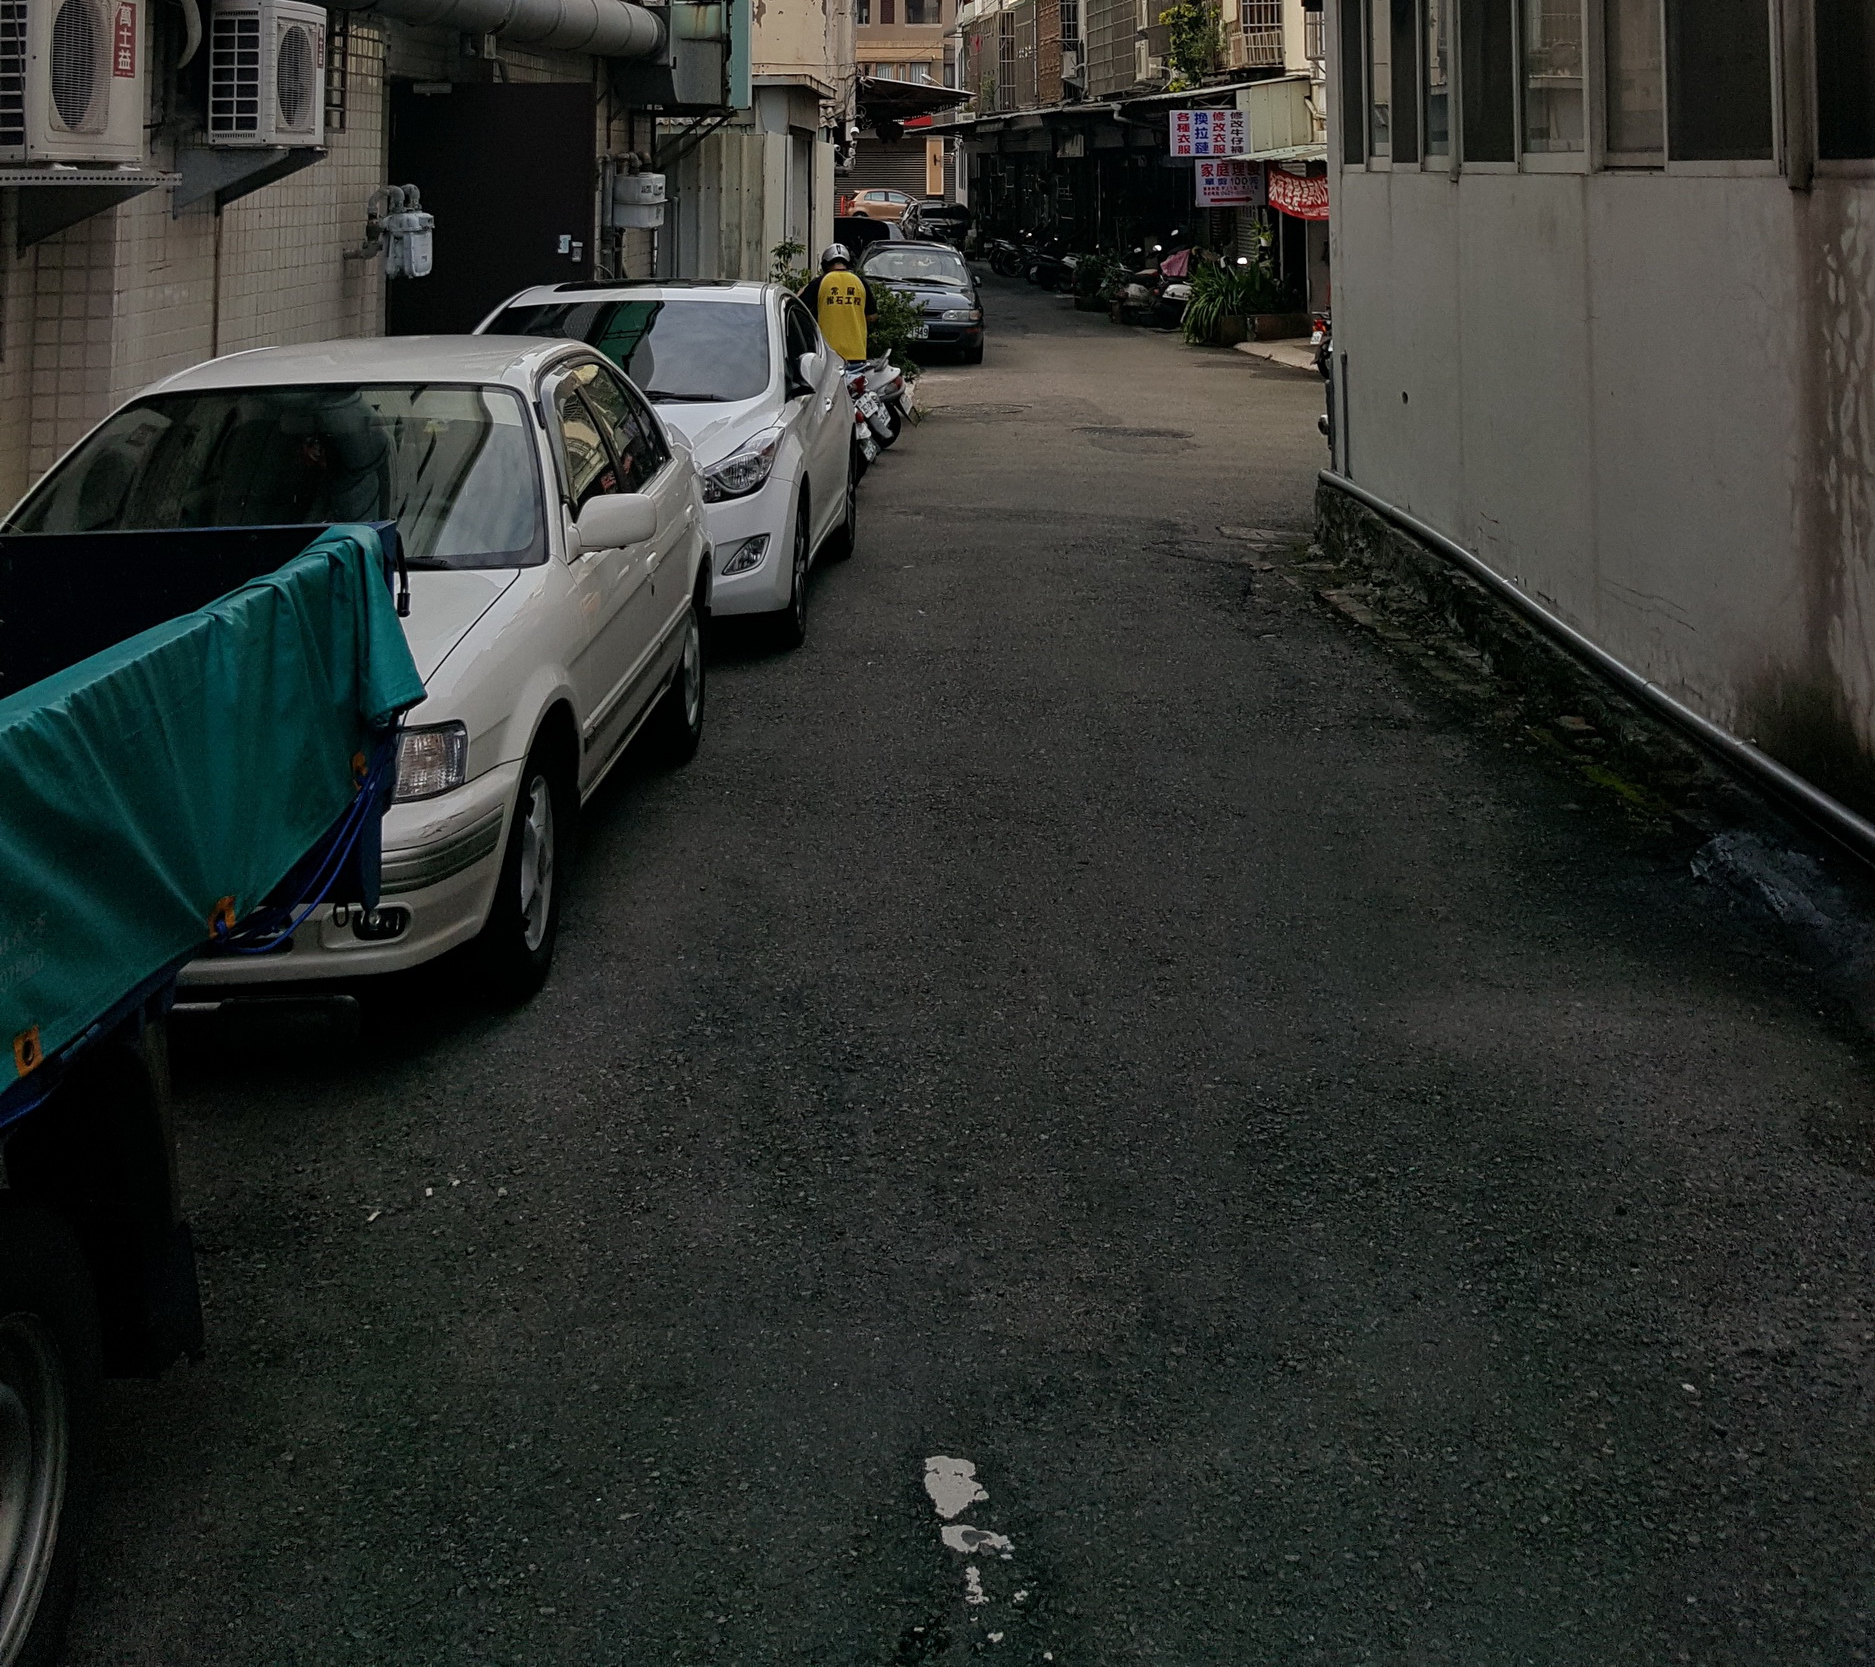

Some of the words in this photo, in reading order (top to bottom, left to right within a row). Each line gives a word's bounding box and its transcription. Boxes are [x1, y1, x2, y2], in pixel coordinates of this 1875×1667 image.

[118, 4, 132, 70] 萬士益
[1177, 112, 1191, 154] 各種衣服
[1194, 112, 1209, 154] 換拉鏈
[1212, 112, 1226, 154] 修改衣服
[1230, 111, 1244, 154] 修改牛仔褲
